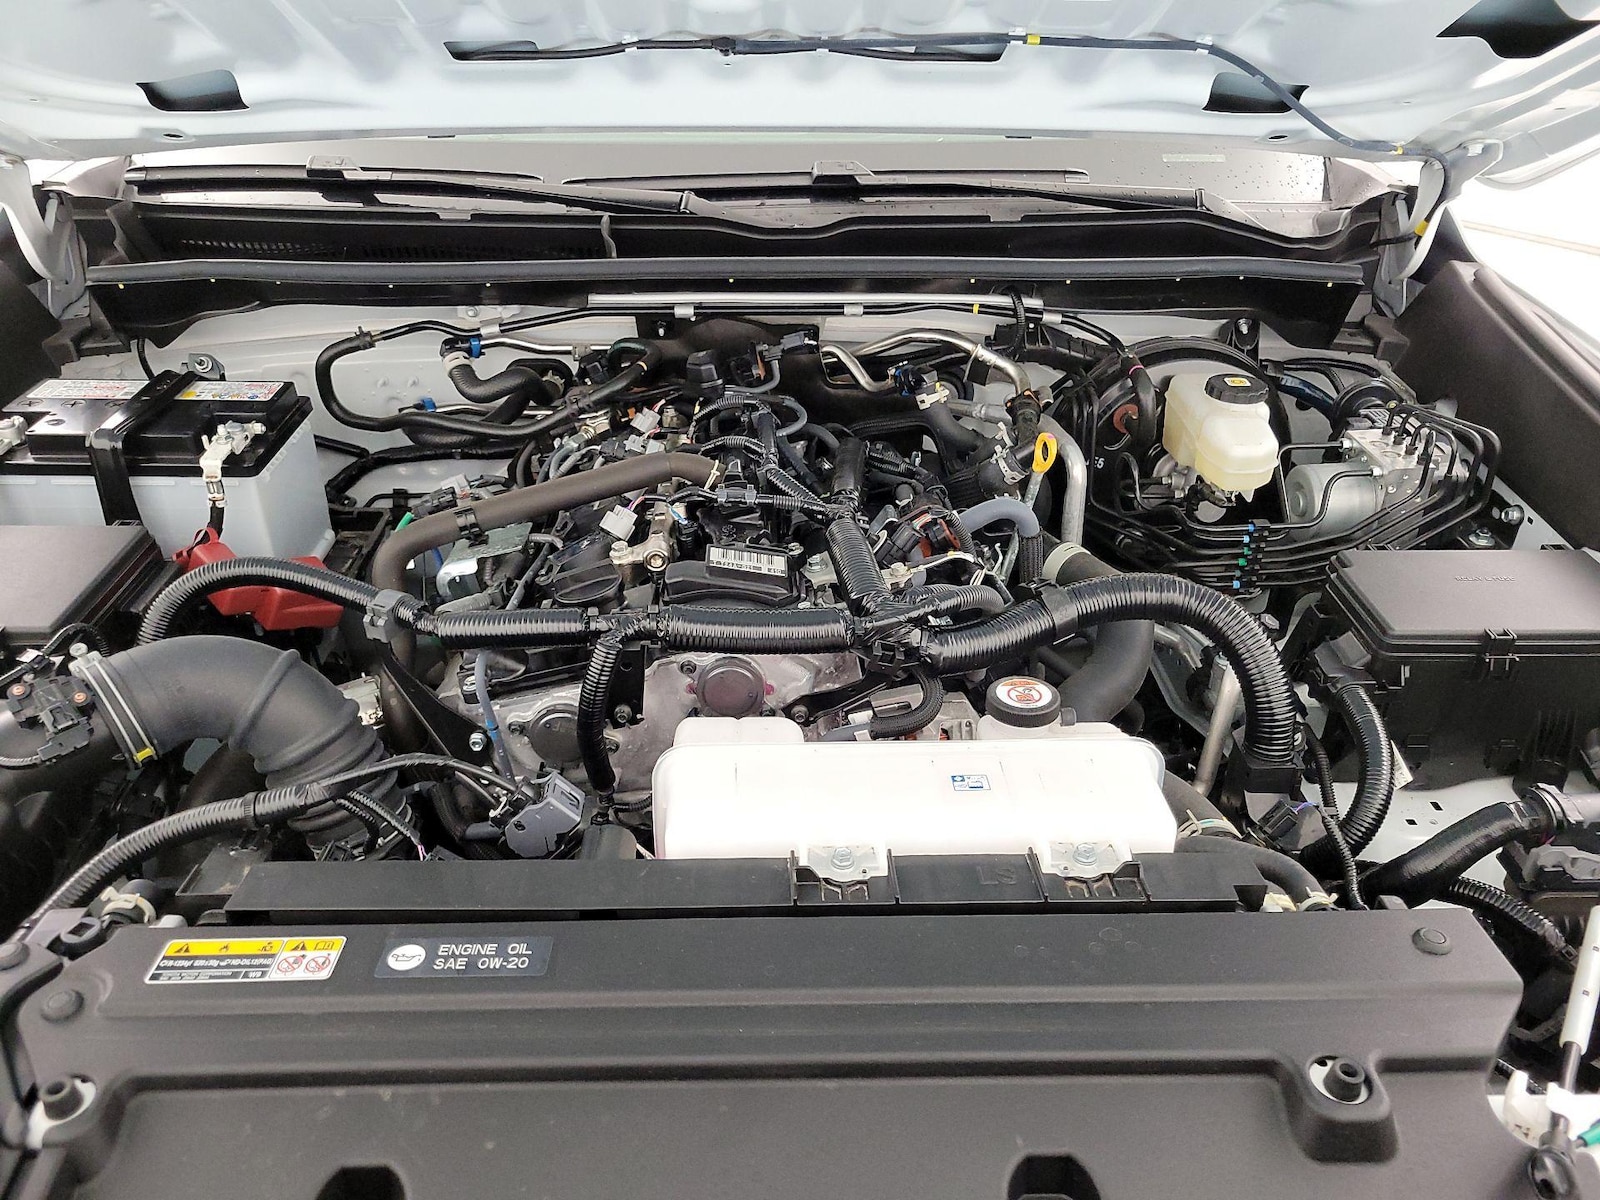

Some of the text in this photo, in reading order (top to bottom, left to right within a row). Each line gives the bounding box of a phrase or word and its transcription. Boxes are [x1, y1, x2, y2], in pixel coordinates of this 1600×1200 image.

[438, 943, 533, 956] ENGINE OIL
[433, 956, 530, 970] SAE 0W-20
